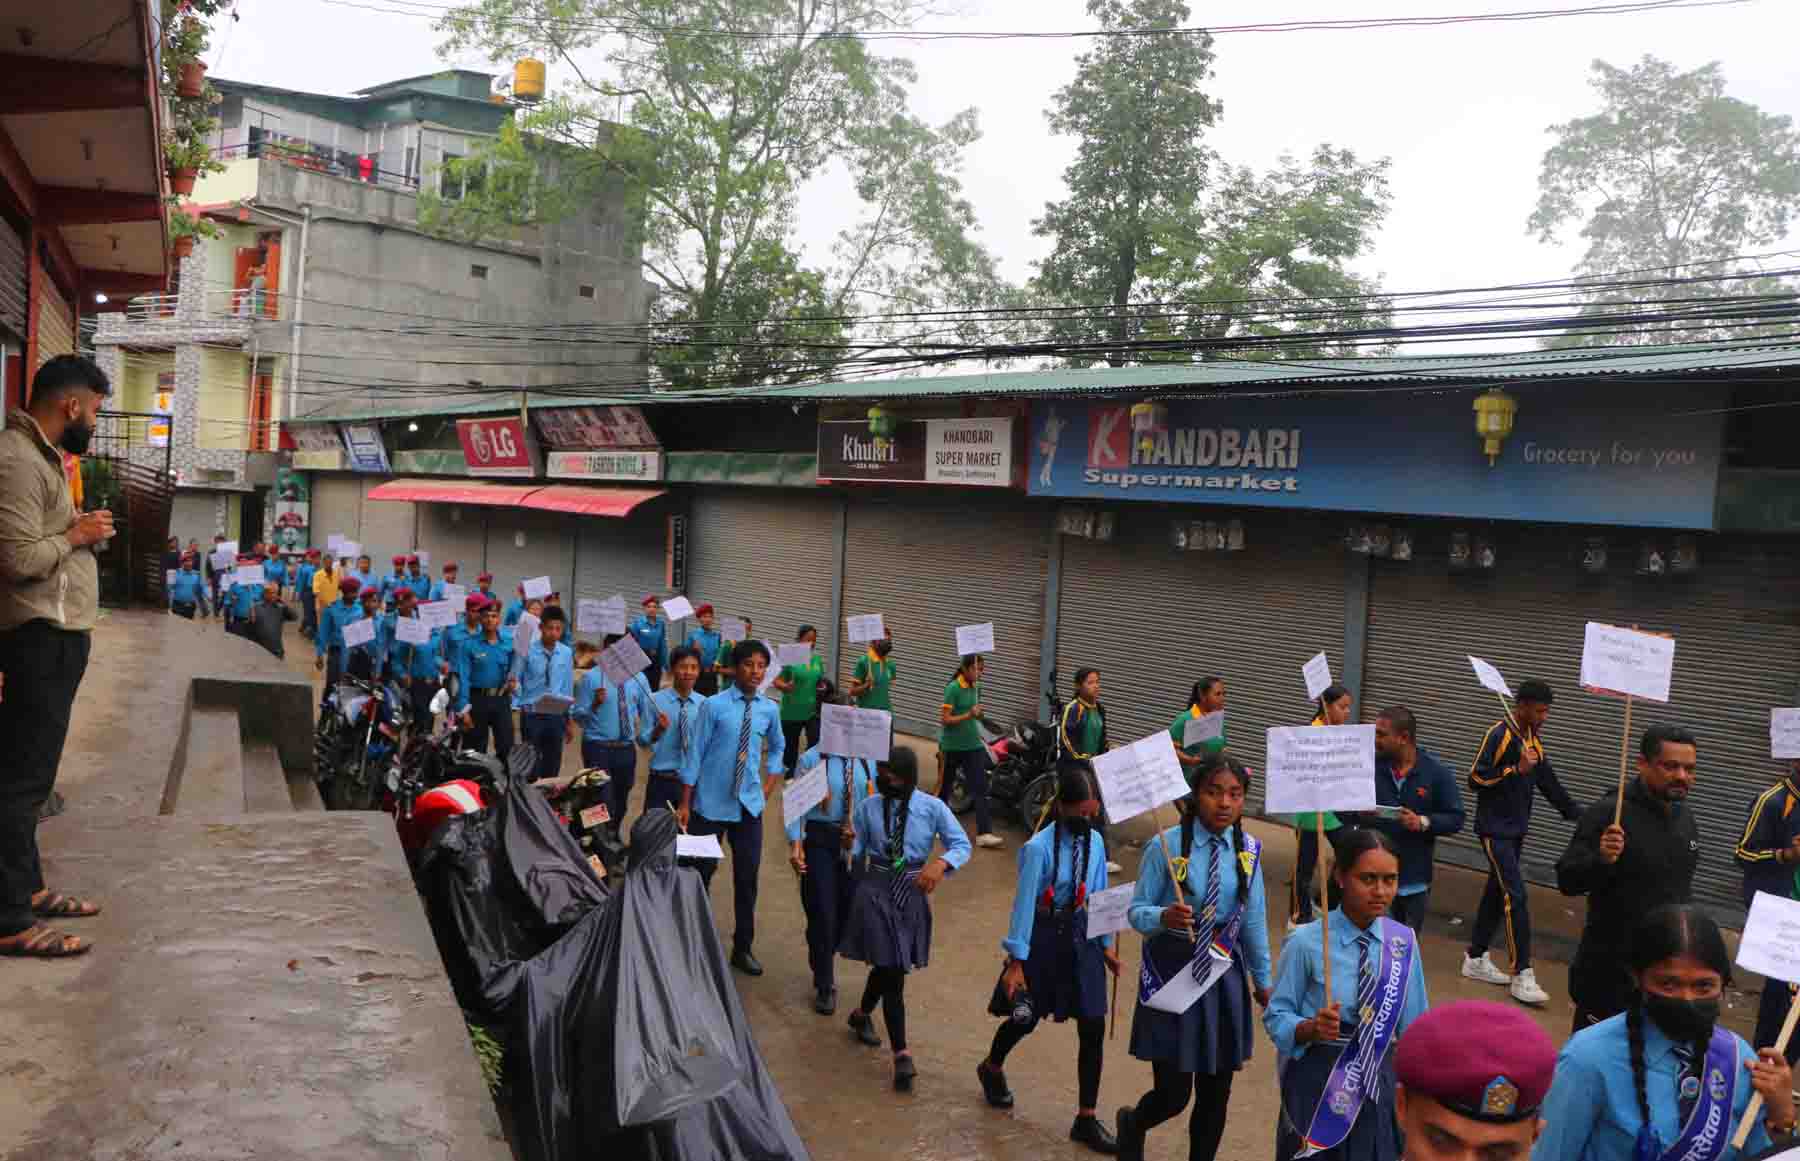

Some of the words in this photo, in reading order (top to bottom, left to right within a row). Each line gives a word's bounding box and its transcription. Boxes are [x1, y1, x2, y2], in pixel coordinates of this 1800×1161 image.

[488, 426, 517, 457] LG
[841, 433, 896, 462] Khukri
[943, 429, 993, 444] KHANDBARI
[935, 451, 963, 465] SUPER
[965, 452, 1001, 466] MARKET
[1523, 441, 1600, 471] Grocery
[1609, 441, 1641, 465] for
[1652, 447, 1697, 473] you
[1085, 470, 1298, 491] Supermarket
